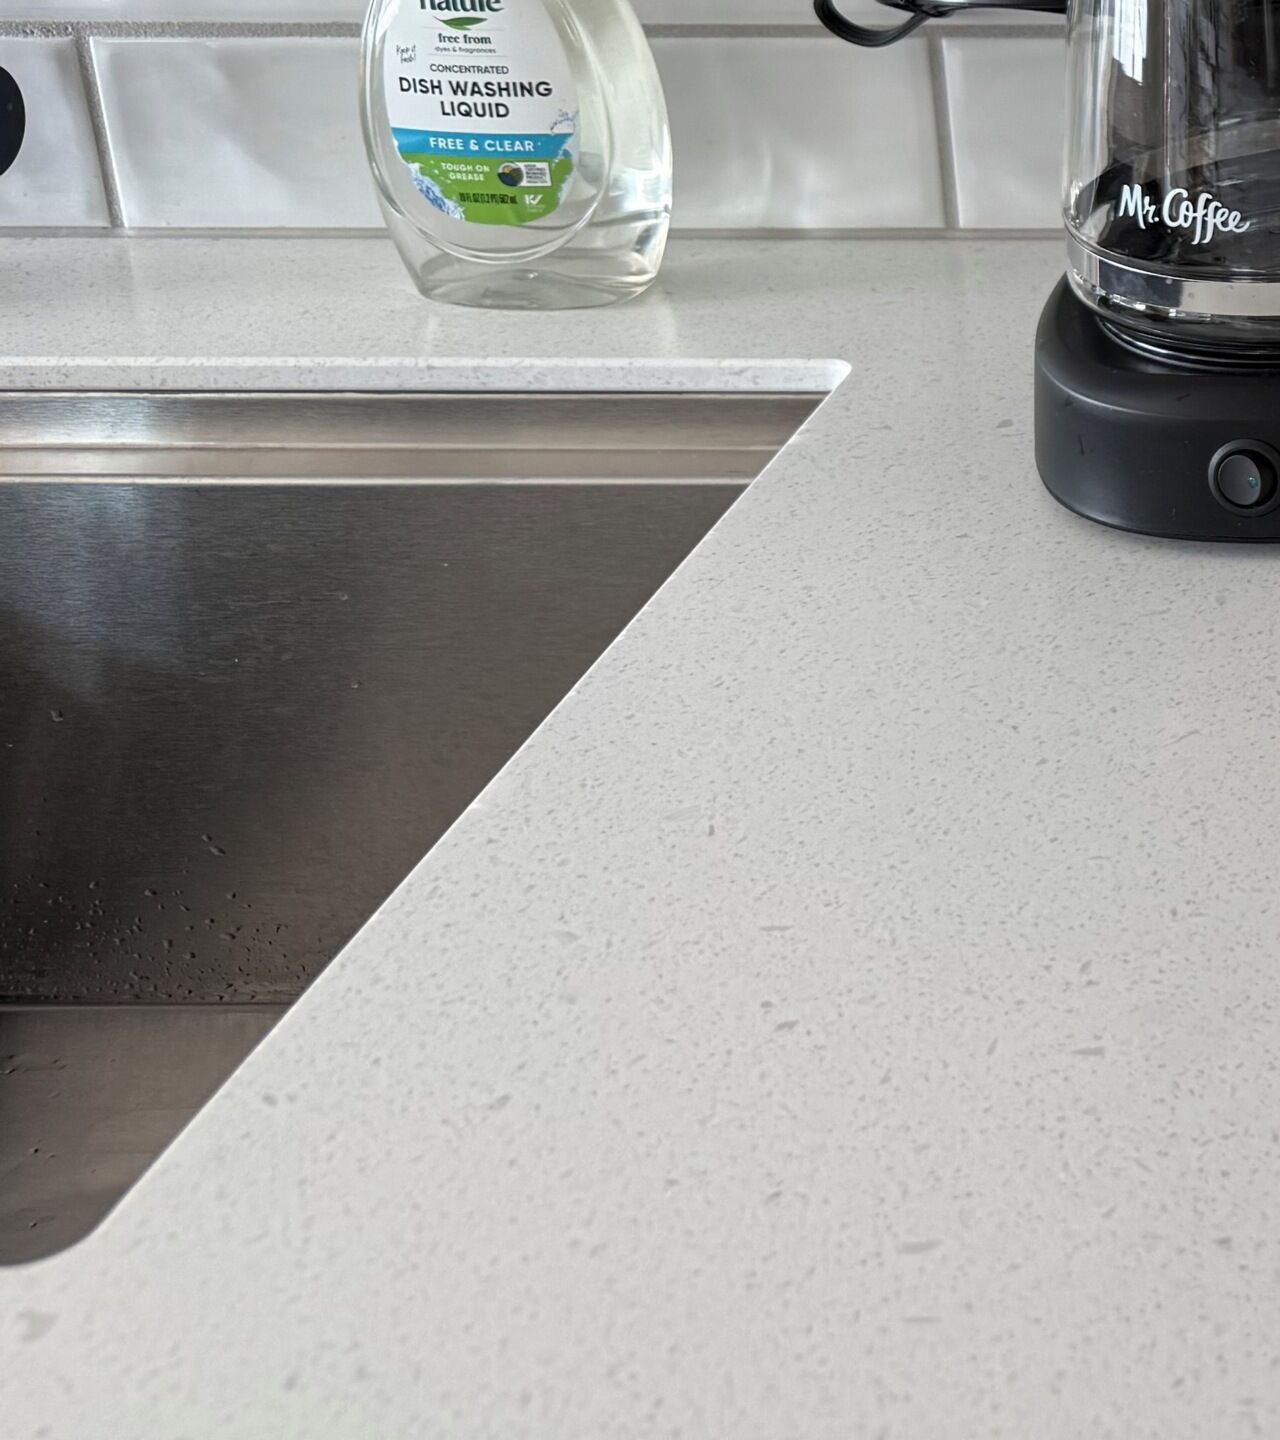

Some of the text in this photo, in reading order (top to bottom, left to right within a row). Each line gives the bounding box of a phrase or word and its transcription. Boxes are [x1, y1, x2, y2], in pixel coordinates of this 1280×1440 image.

[438, 33, 492, 45] free from
[430, 63, 509, 75] CONCENTRATED
[399, 76, 553, 97] DISH WASHING
[440, 100, 510, 119] LIQUID
[429, 137, 534, 152] FREE & CLEAR
[441, 162, 490, 173] TOUGH ON
[449, 172, 485, 182] GREASE
[1118, 184, 1250, 245] Mr. Coffee
